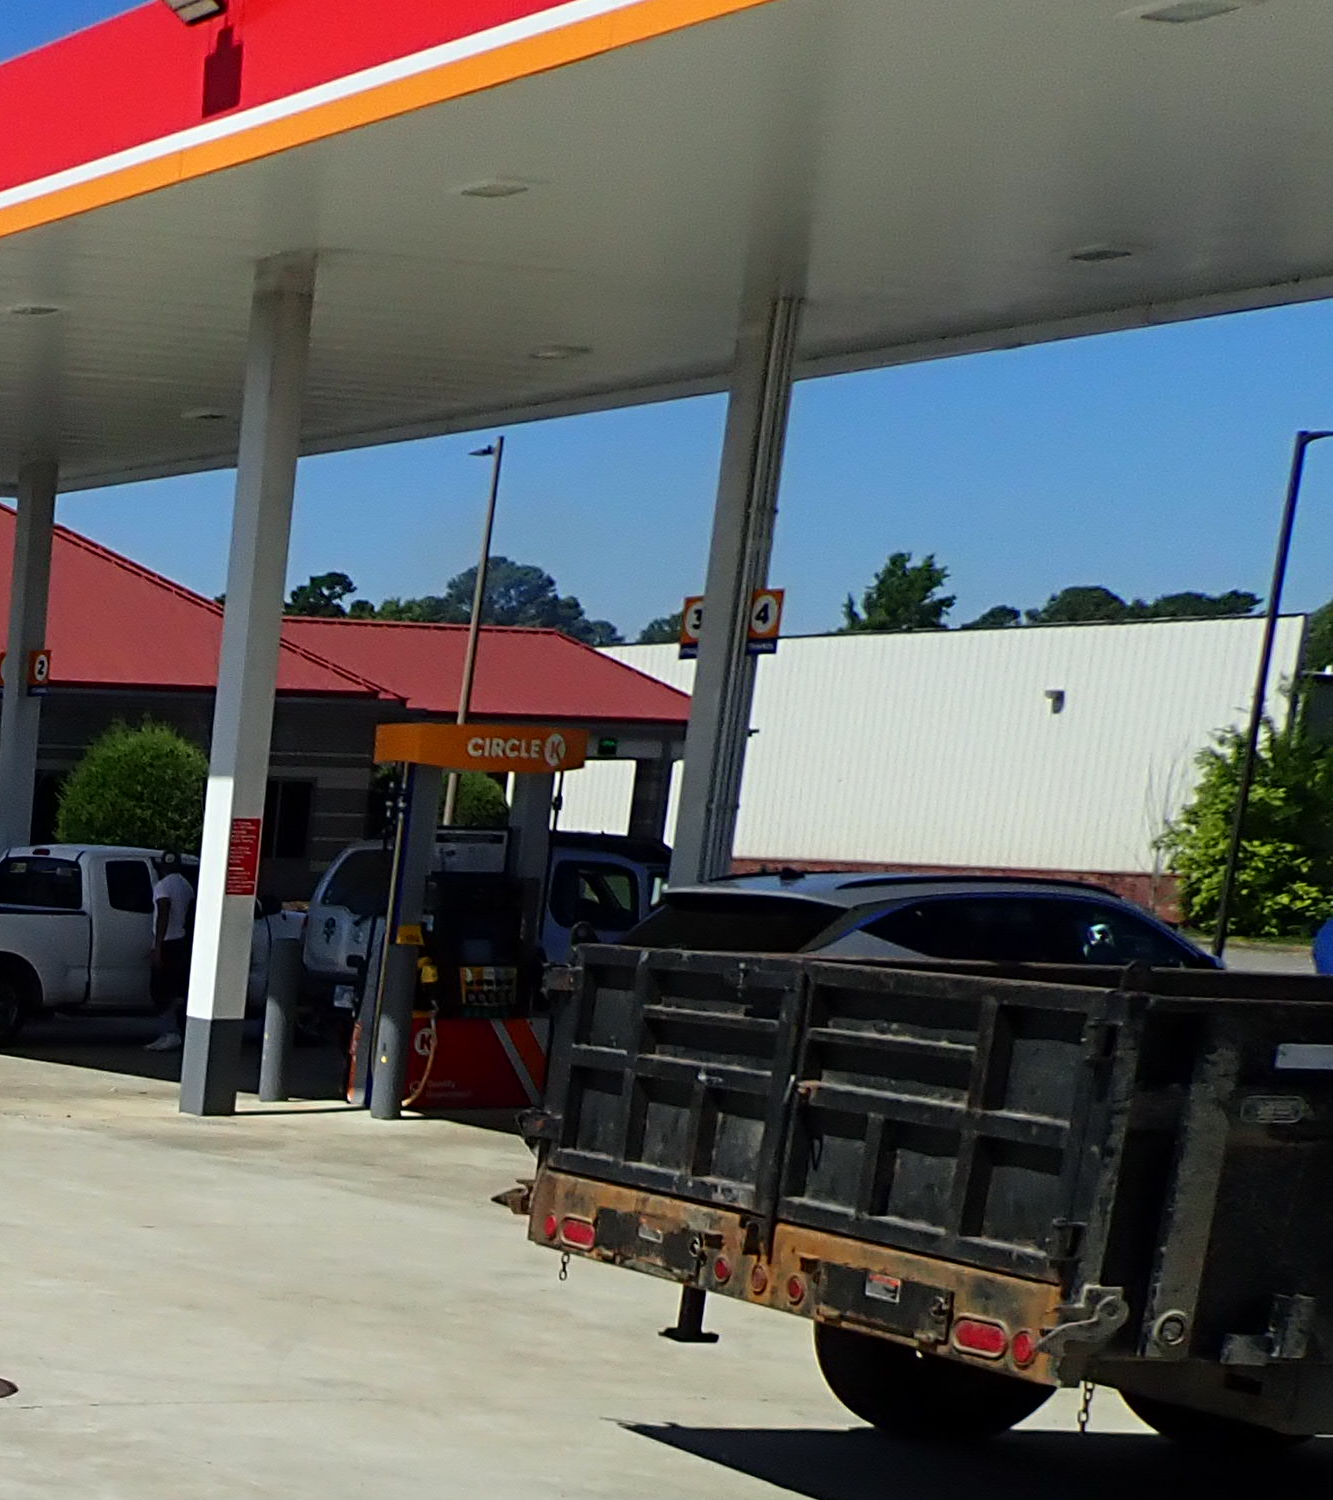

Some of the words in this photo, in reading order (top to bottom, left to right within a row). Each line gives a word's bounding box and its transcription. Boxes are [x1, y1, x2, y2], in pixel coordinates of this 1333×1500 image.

[755, 604, 770, 624] 4
[37, 660, 46, 676] 2
[467, 737, 542, 758] CIRCLE
[544, 733, 566, 767] K
